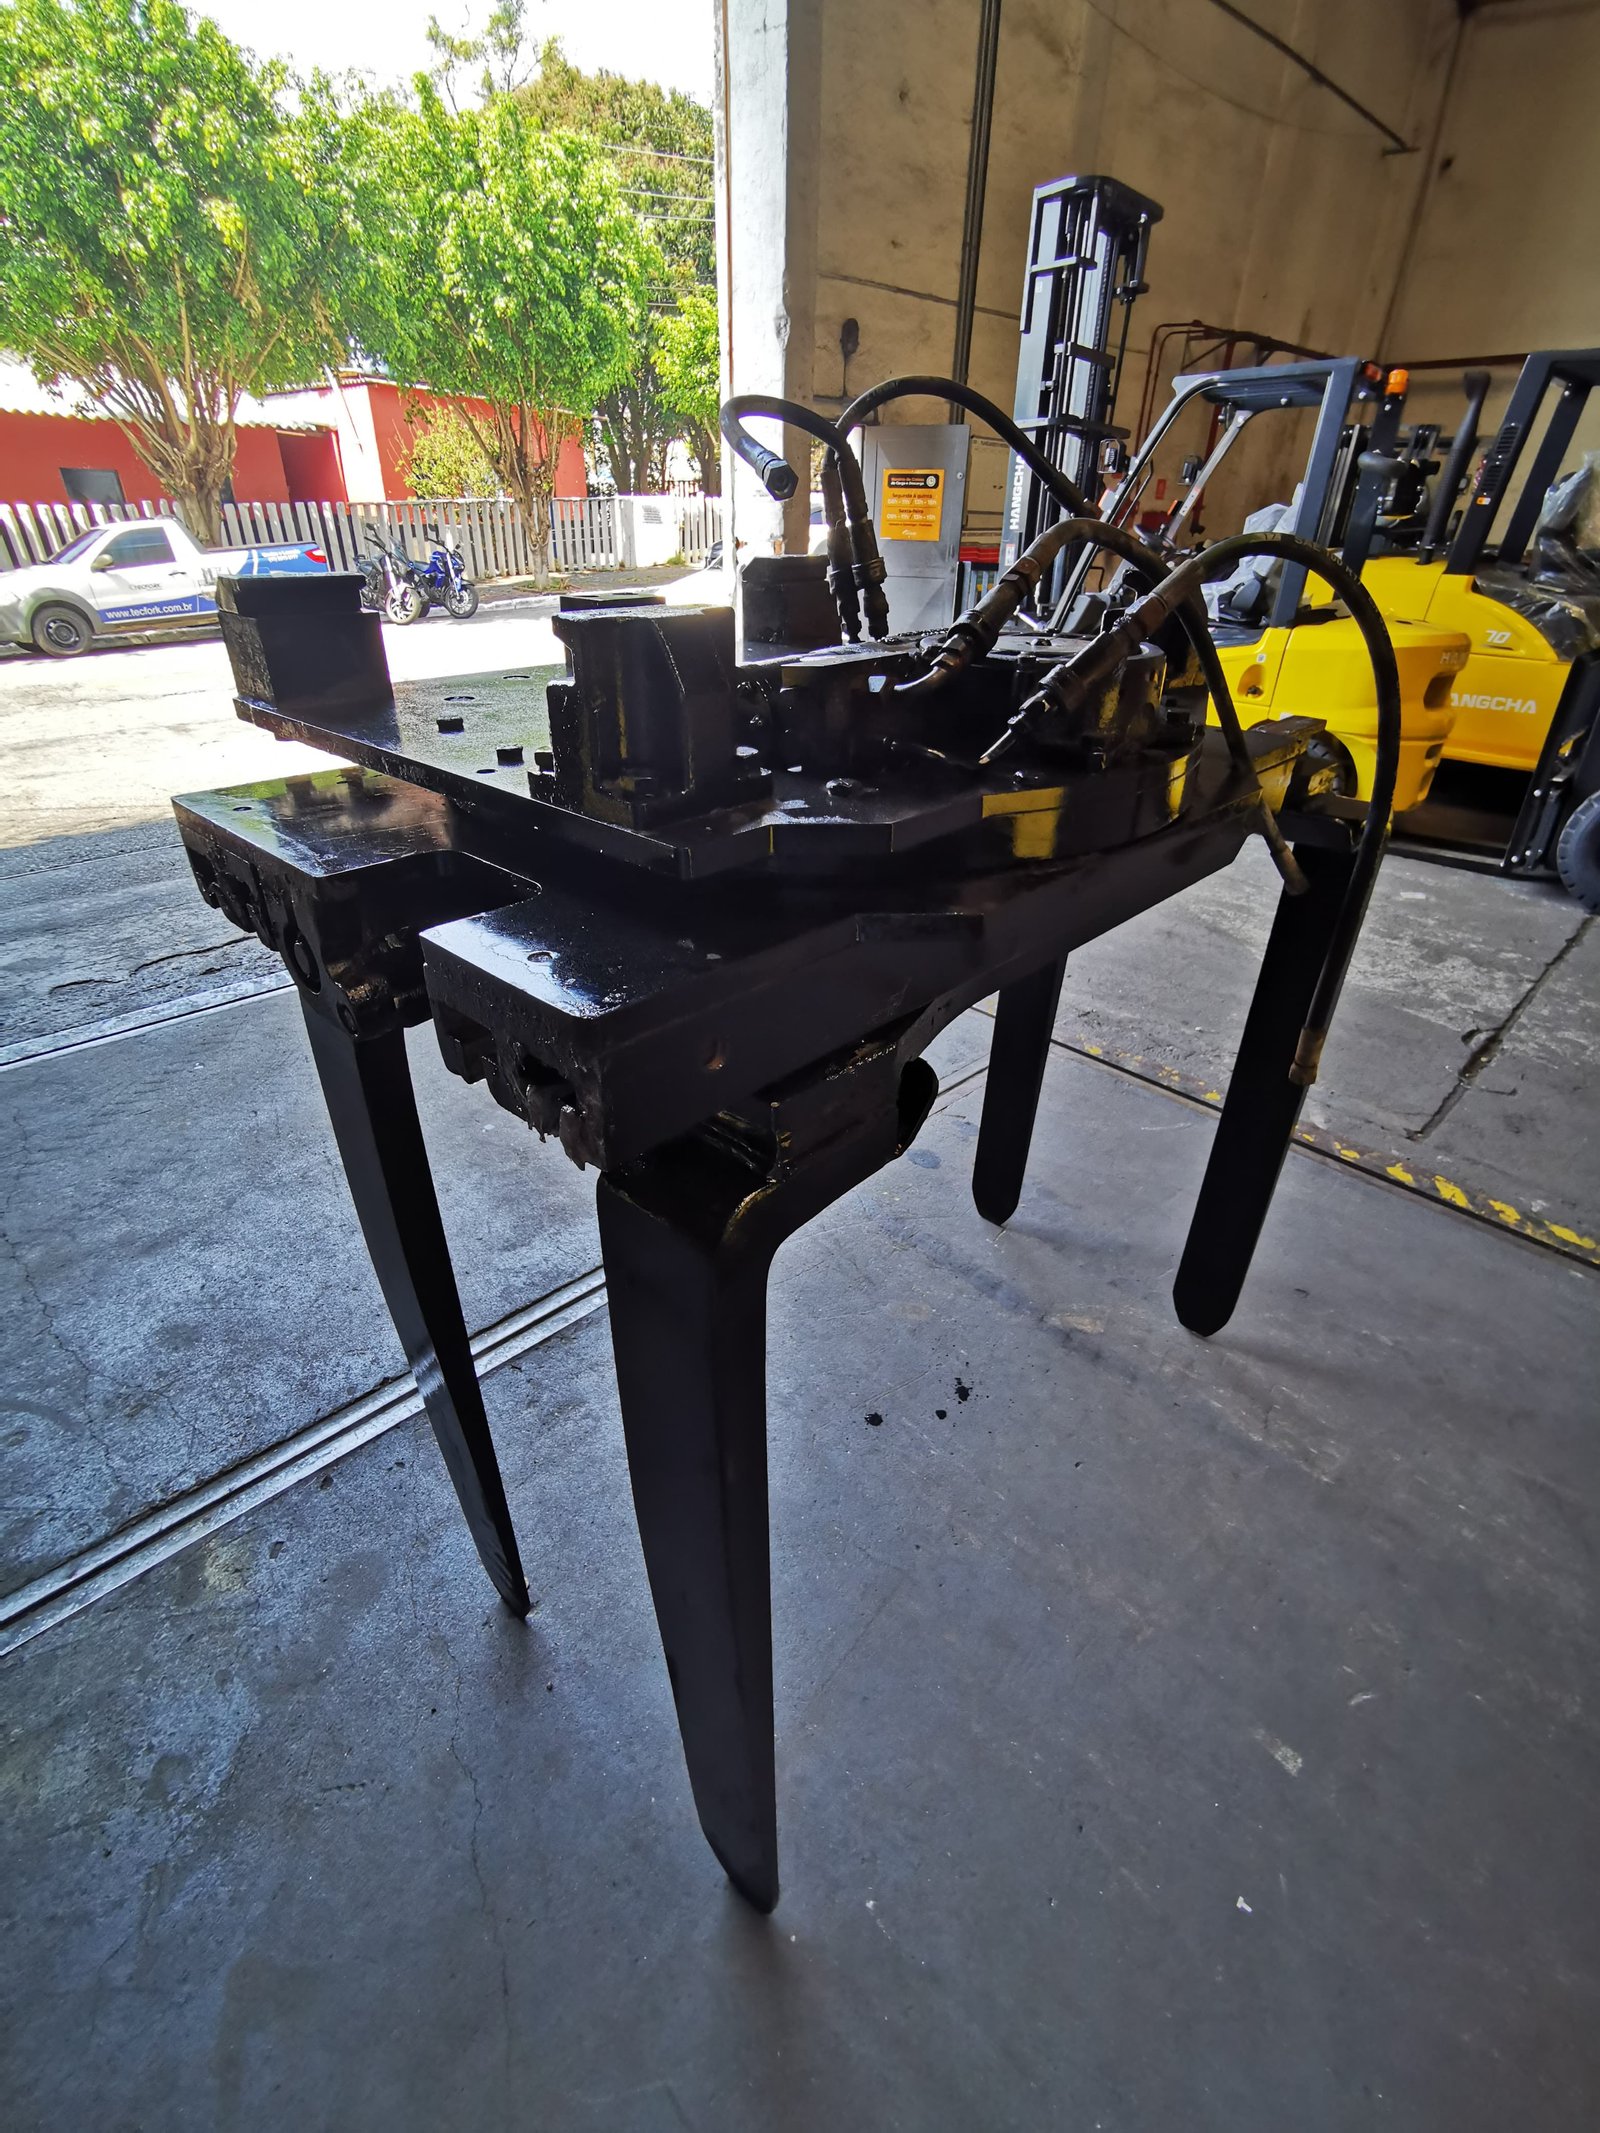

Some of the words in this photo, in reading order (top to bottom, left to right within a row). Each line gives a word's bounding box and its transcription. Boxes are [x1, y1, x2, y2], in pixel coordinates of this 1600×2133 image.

[106, 602, 193, 619] www.tecfork.com.br
[1485, 629, 1511, 644] 70
[1450, 692, 1536, 714] ANGCHA
